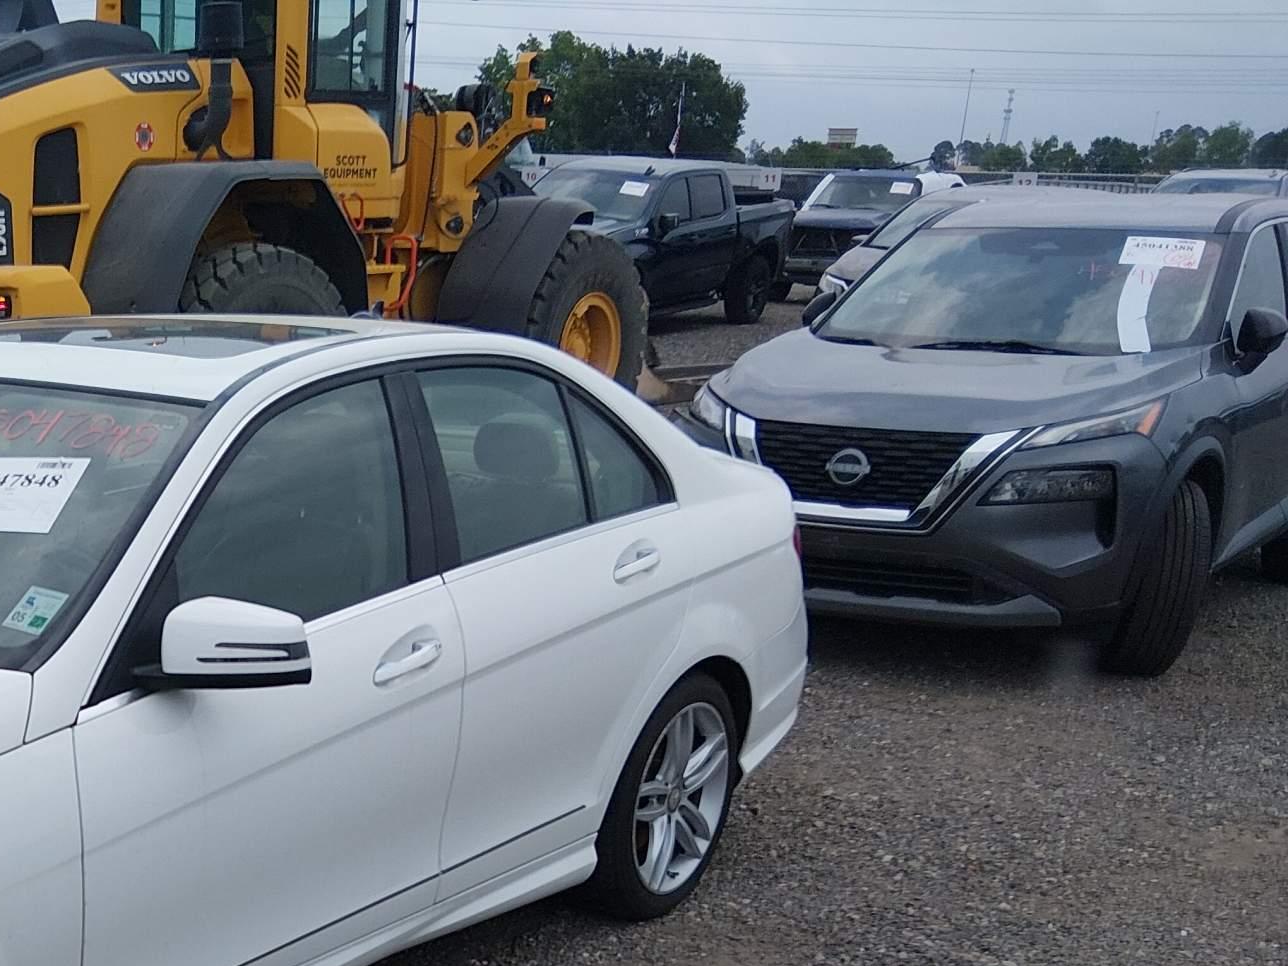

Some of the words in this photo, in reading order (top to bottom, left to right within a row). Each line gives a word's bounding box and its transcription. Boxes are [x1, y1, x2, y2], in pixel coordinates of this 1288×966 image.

[121, 69, 191, 85] VOLVO
[335, 155, 367, 167] SCOTT
[323, 167, 378, 179] EQUIPMENT
[765, 174, 776, 183] 11
